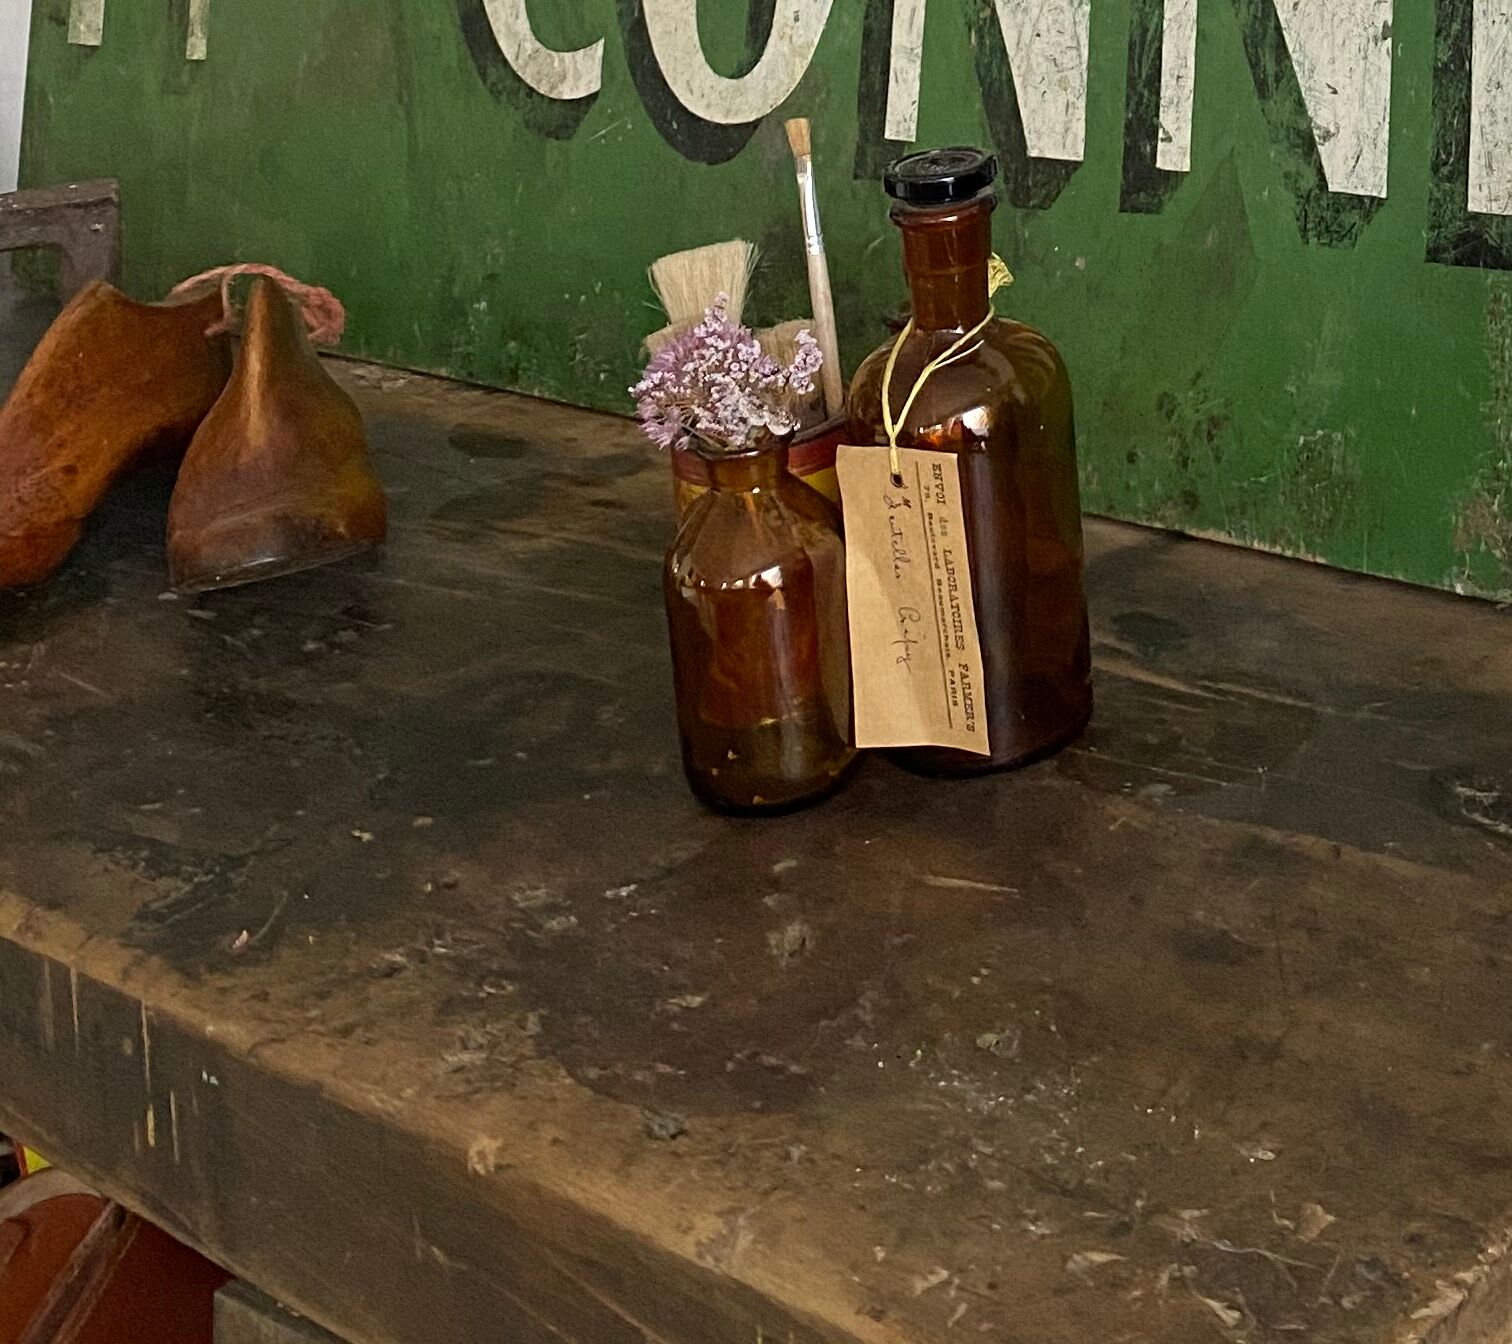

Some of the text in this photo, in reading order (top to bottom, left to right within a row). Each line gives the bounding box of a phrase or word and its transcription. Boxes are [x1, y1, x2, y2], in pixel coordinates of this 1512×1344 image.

[932, 463, 946, 505] ENVOI
[959, 663, 976, 733] FARMER'S
[949, 669, 959, 707] PARIS
